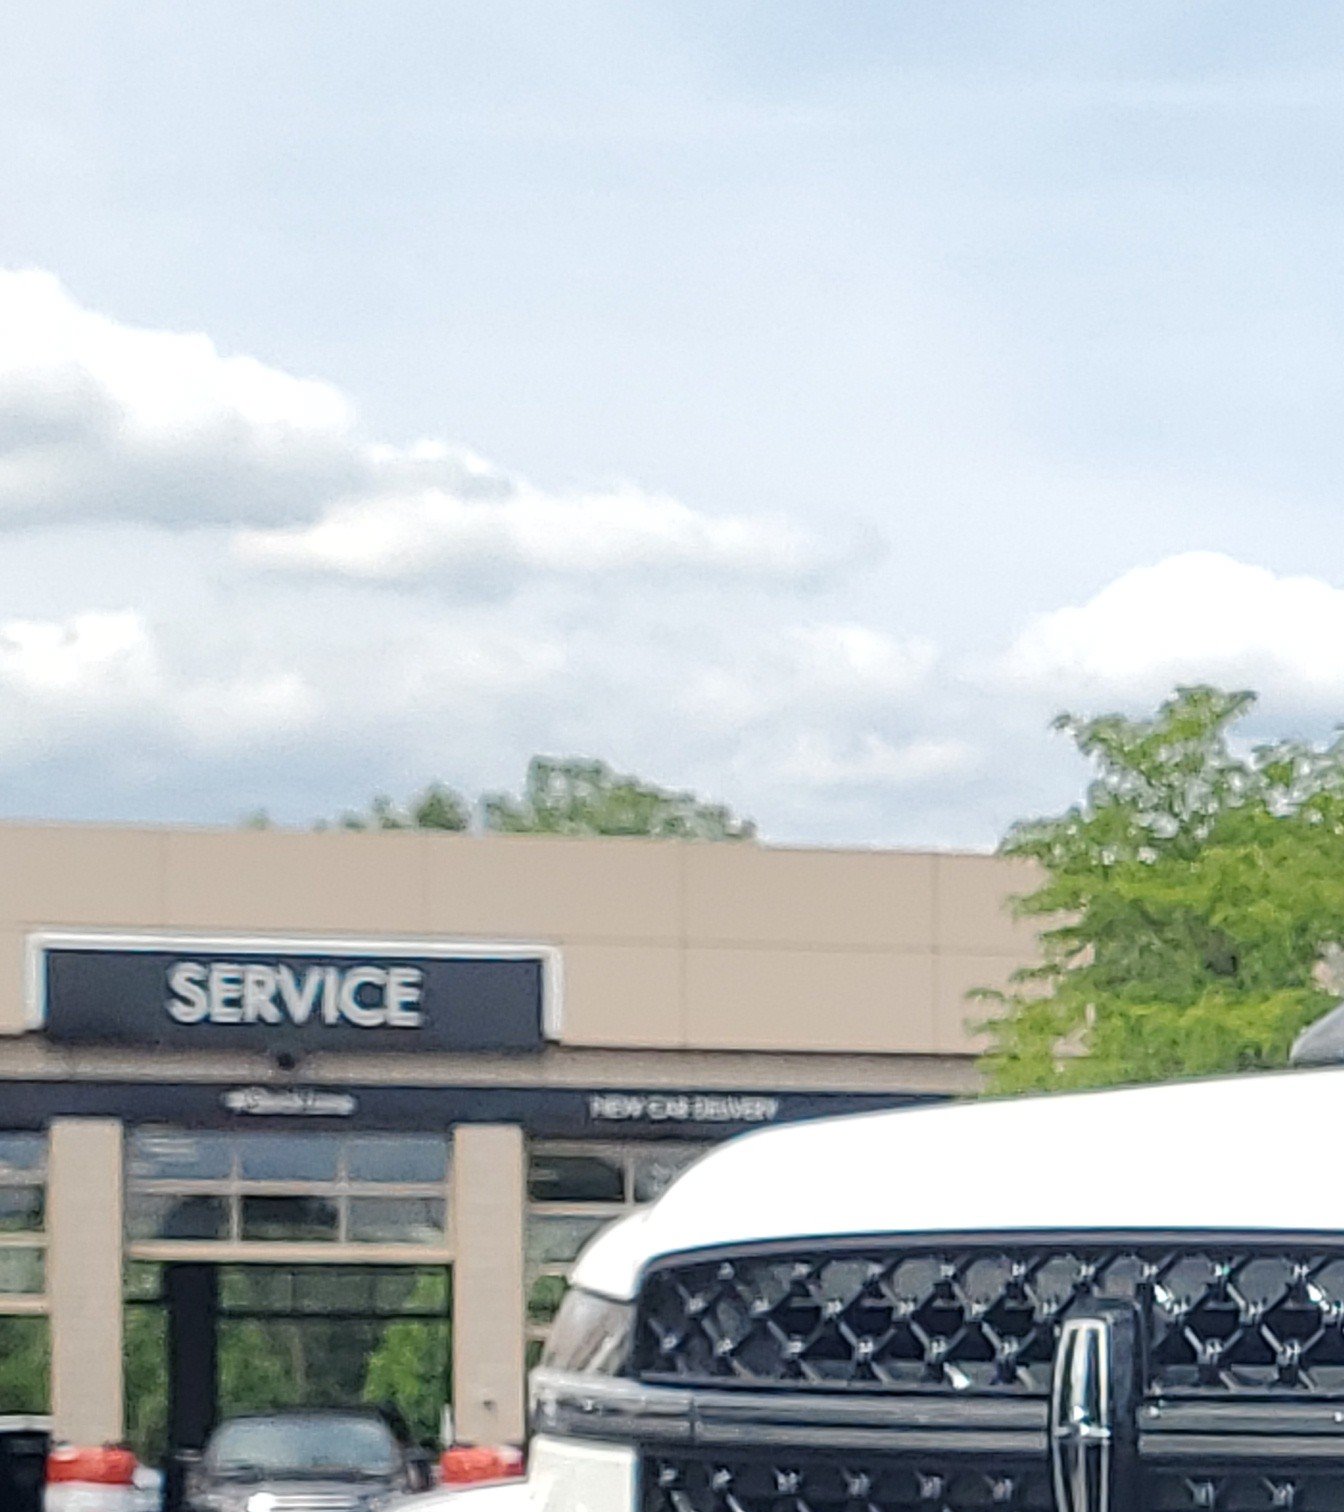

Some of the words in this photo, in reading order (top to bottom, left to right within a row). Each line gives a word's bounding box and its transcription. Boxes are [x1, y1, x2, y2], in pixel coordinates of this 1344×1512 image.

[168, 961, 423, 1027] SERVICE
[590, 1094, 645, 1120] NEW
[647, 1095, 689, 1120] CAR
[694, 1096, 778, 1121] DELIVERY
